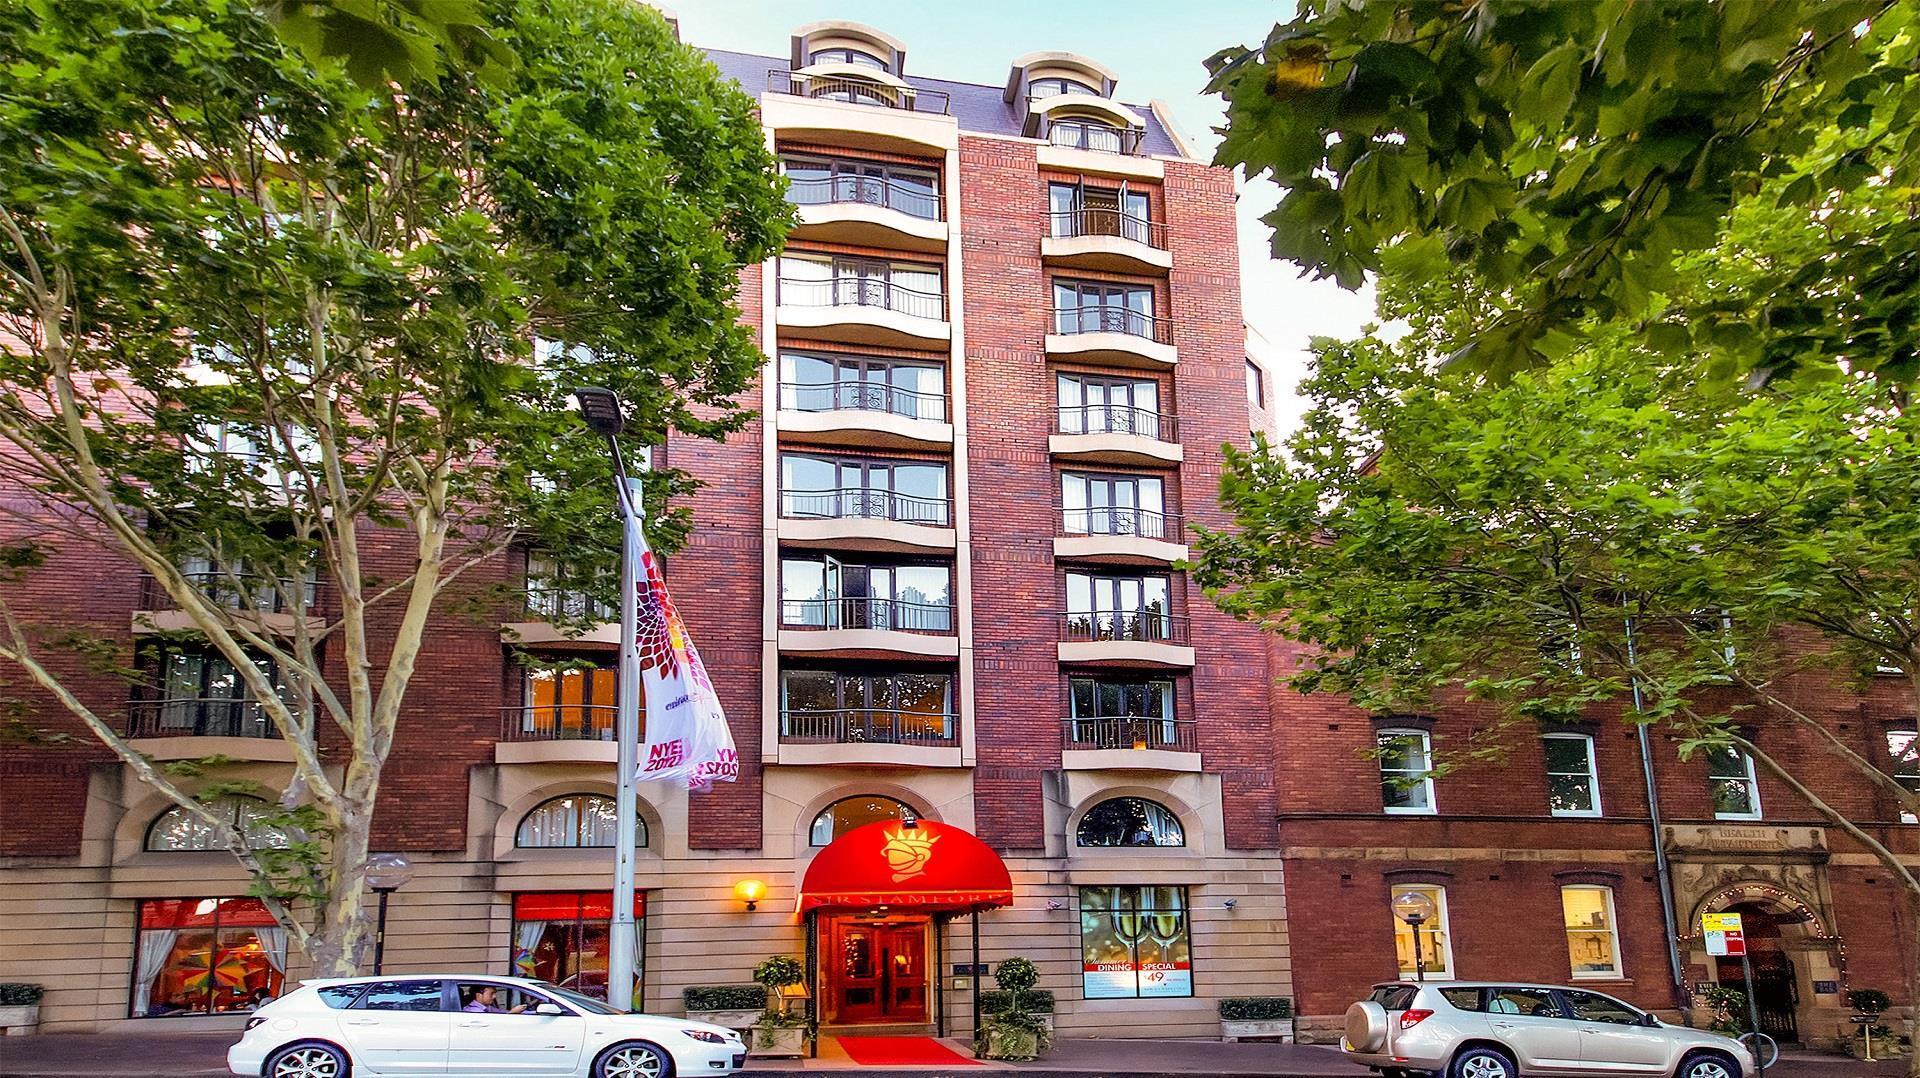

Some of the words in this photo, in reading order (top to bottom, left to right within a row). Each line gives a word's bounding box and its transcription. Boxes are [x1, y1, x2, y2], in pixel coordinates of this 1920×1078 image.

[650, 739, 682, 759] NYE
[812, 896, 852, 904] SIR
[1098, 963, 1132, 972] DINING
[1142, 962, 1176, 971] SPECIAL
